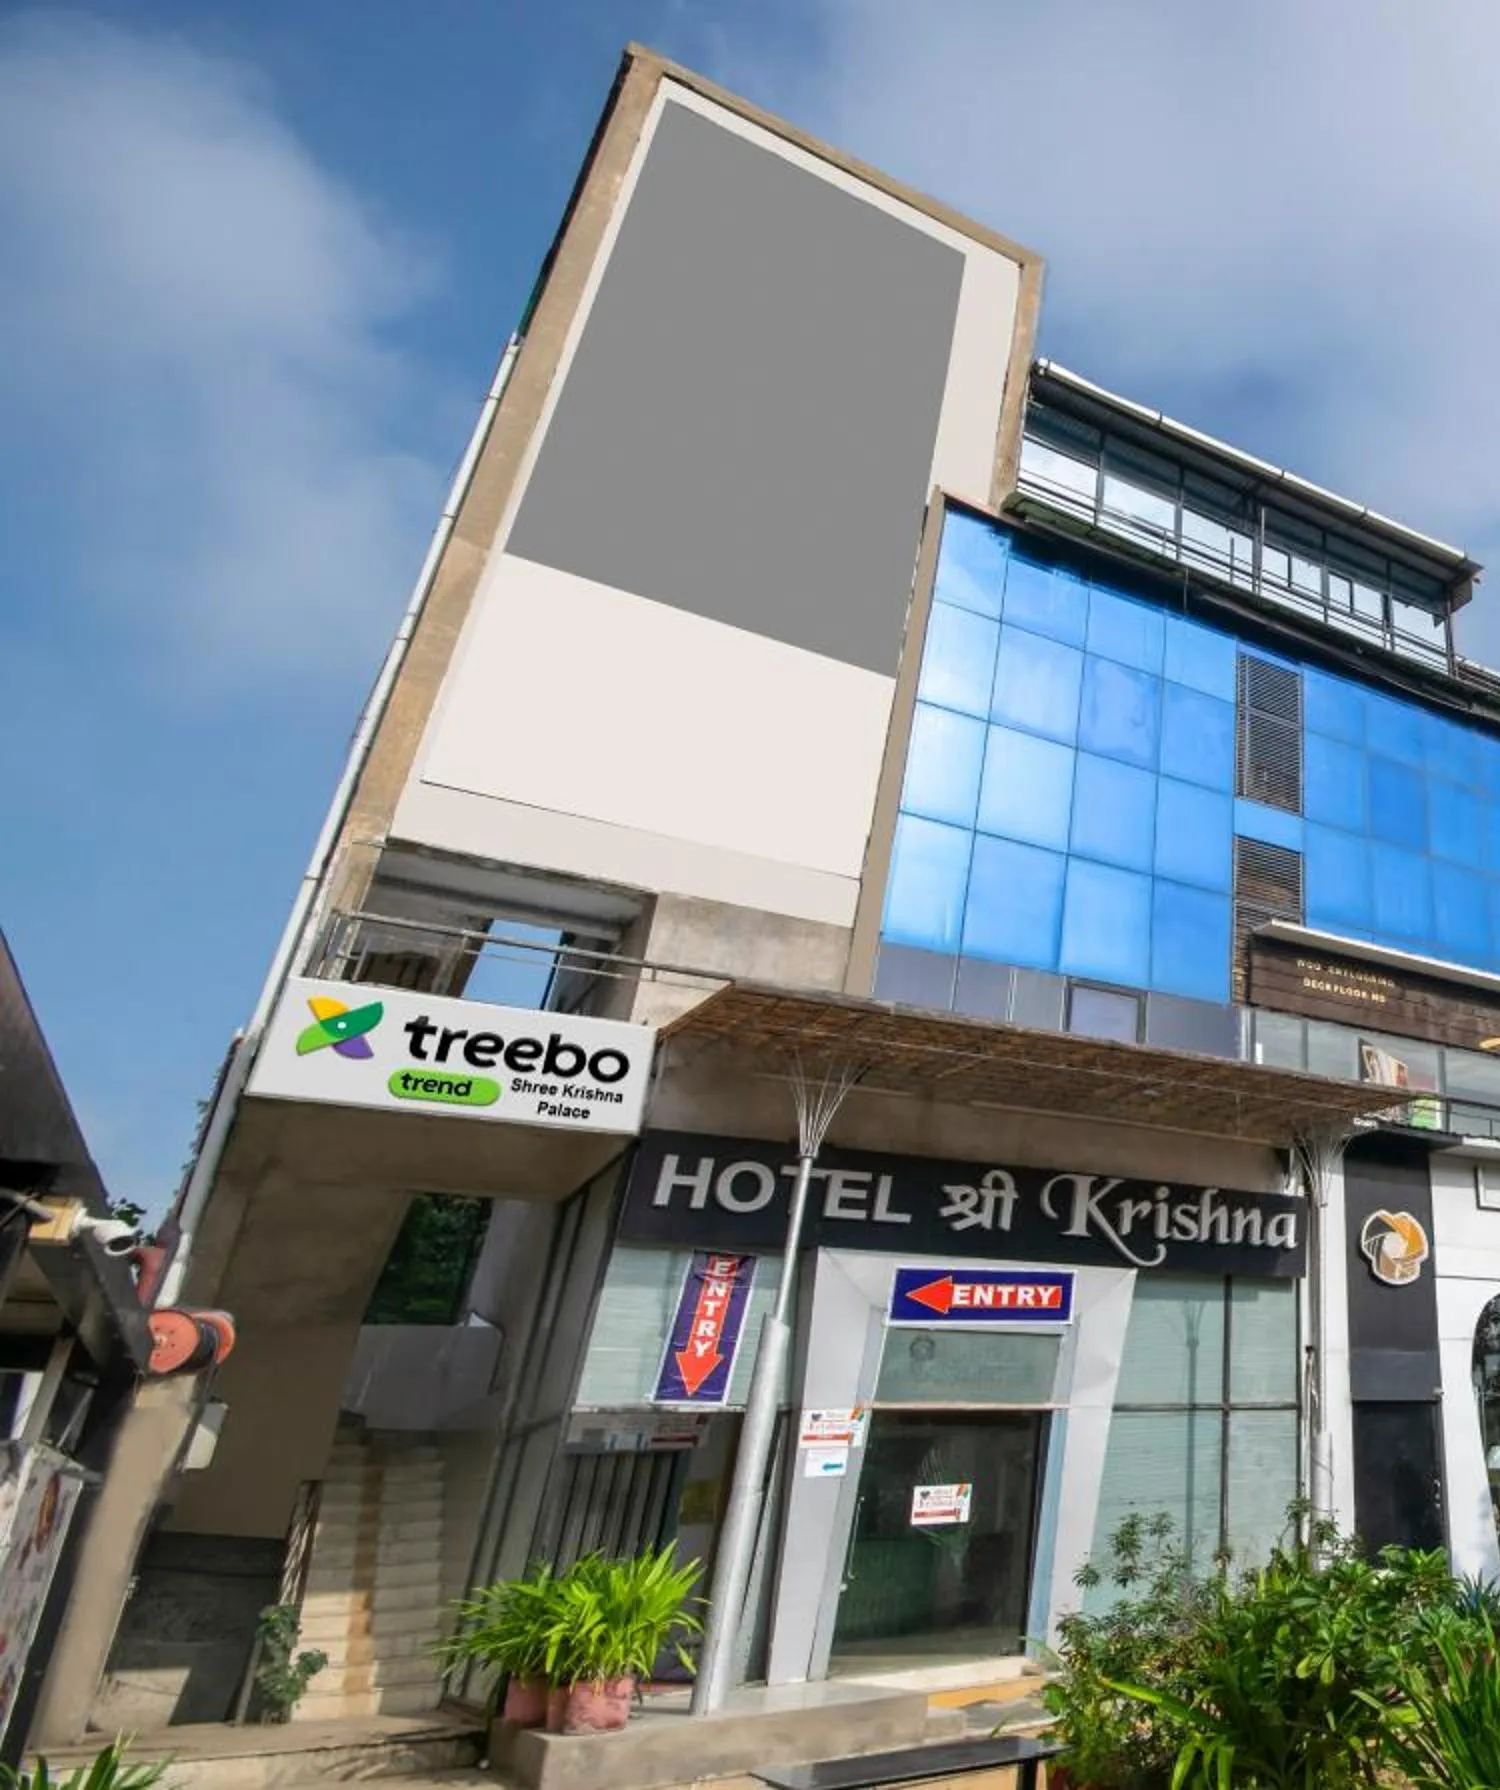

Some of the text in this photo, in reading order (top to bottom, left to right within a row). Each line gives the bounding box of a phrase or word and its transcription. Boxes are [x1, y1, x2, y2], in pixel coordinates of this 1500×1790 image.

[404, 1015, 630, 1083] treebo
[401, 1072, 472, 1098] trend
[511, 1077, 624, 1104] Shree Krishna
[537, 1100, 591, 1121] Palace
[652, 1153, 1300, 1268] HOTEL श्री Krishna
[693, 1260, 731, 1357] ENTRY
[952, 1285, 1059, 1307] ENTRY
